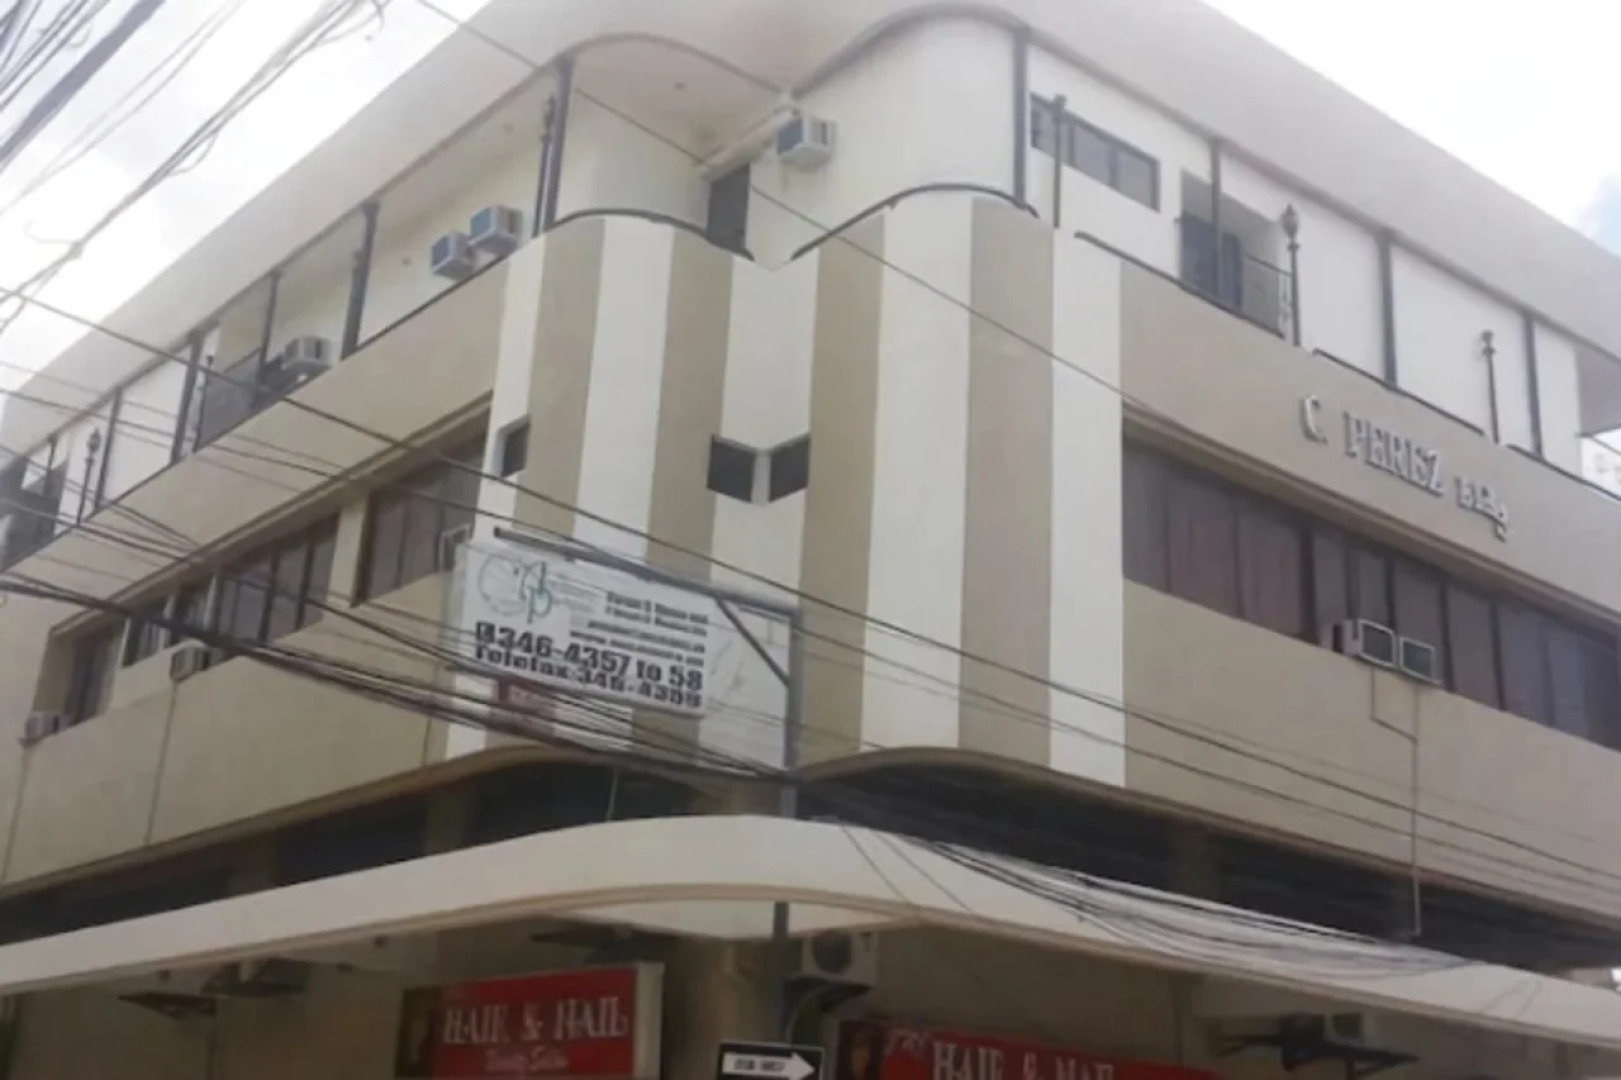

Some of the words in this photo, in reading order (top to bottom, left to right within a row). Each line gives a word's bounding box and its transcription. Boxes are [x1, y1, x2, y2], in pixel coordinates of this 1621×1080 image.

[1344, 411, 1445, 497] PEREZ
[498, 626, 632, 676] 346-4357
[636, 660, 662, 682] to
[669, 664, 703, 691] 58
